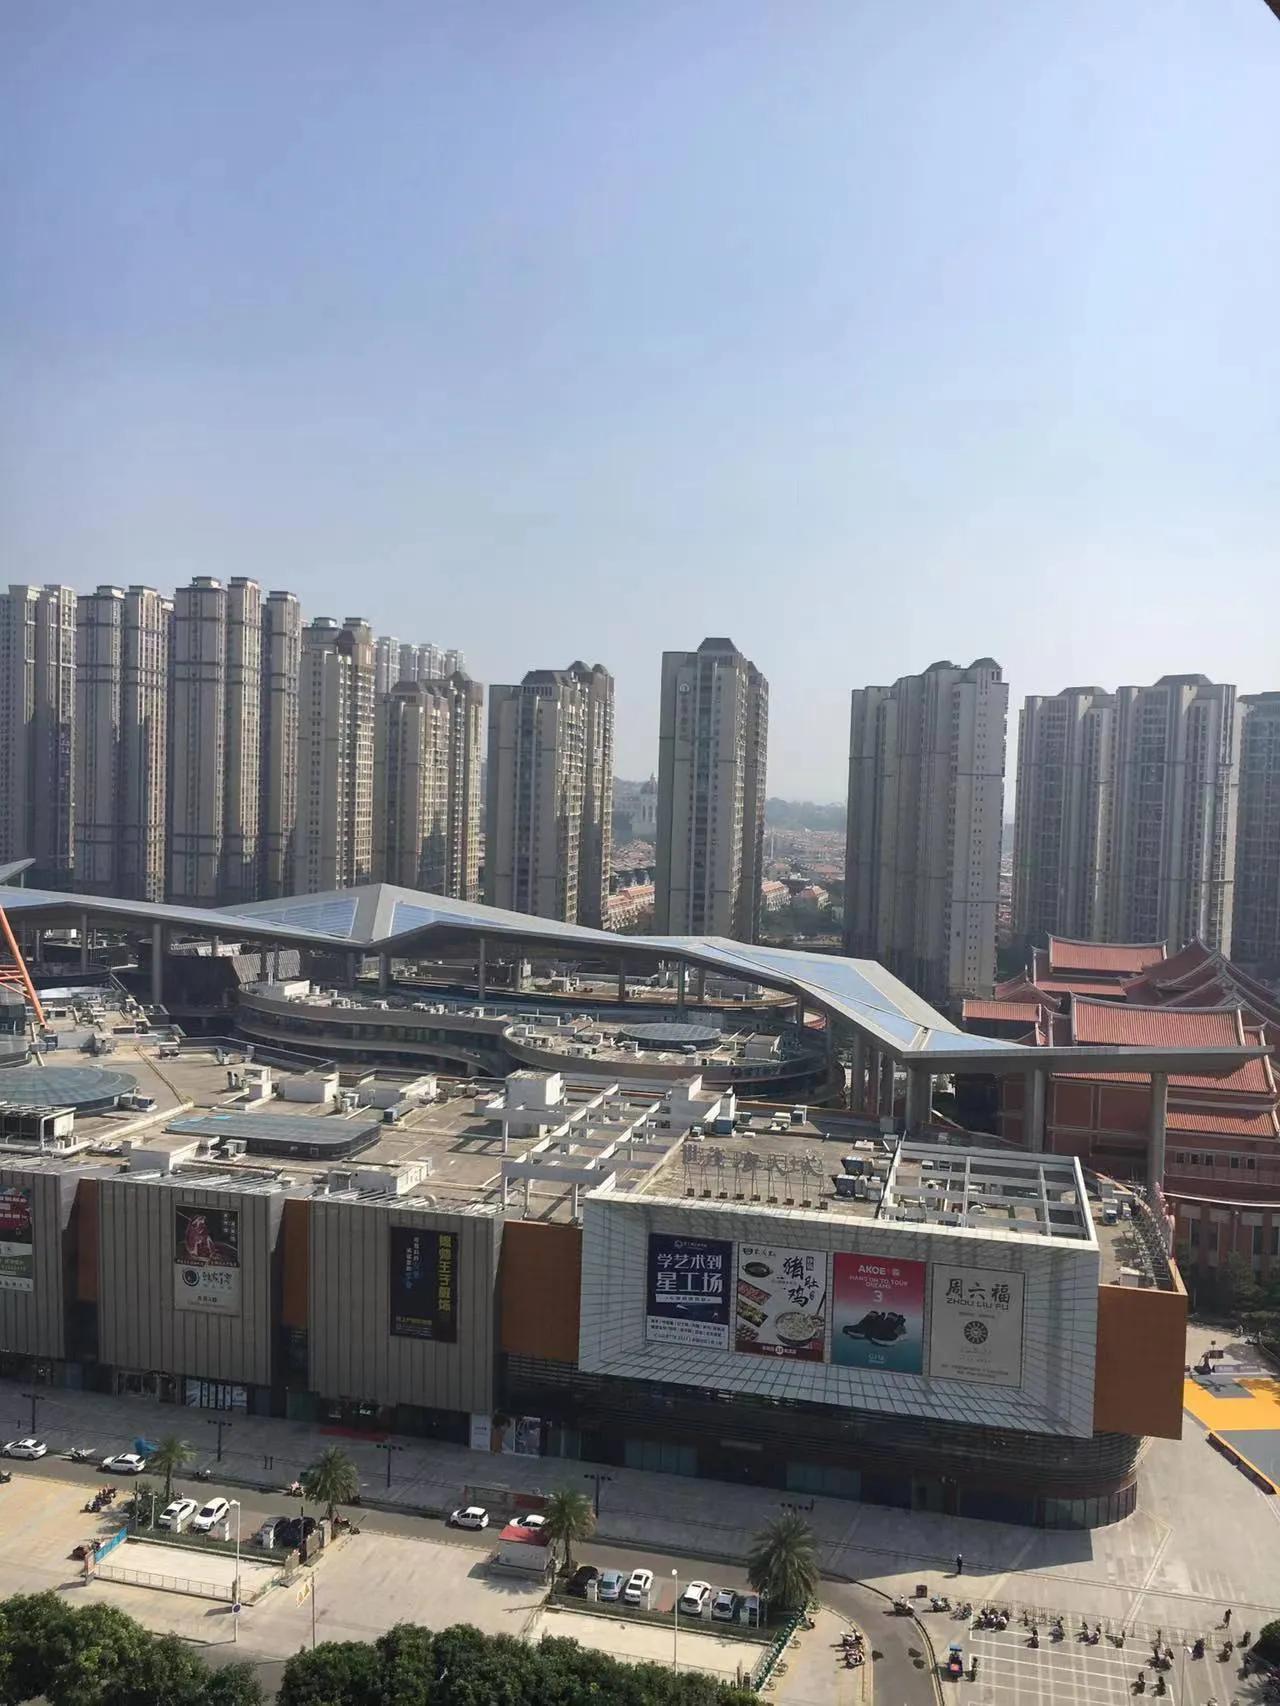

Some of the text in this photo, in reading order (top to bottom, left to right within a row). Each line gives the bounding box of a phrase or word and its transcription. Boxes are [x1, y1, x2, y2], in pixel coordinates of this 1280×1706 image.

[656, 1253, 722, 1270] 学艺术到
[858, 1264, 886, 1275] AKOE
[656, 1271, 723, 1293] 星工场
[873, 1290, 882, 1302] 3
[945, 1278, 1010, 1303] 周六福
[946, 1297, 974, 1306] ZHOU
[977, 1301, 992, 1309] LIU
